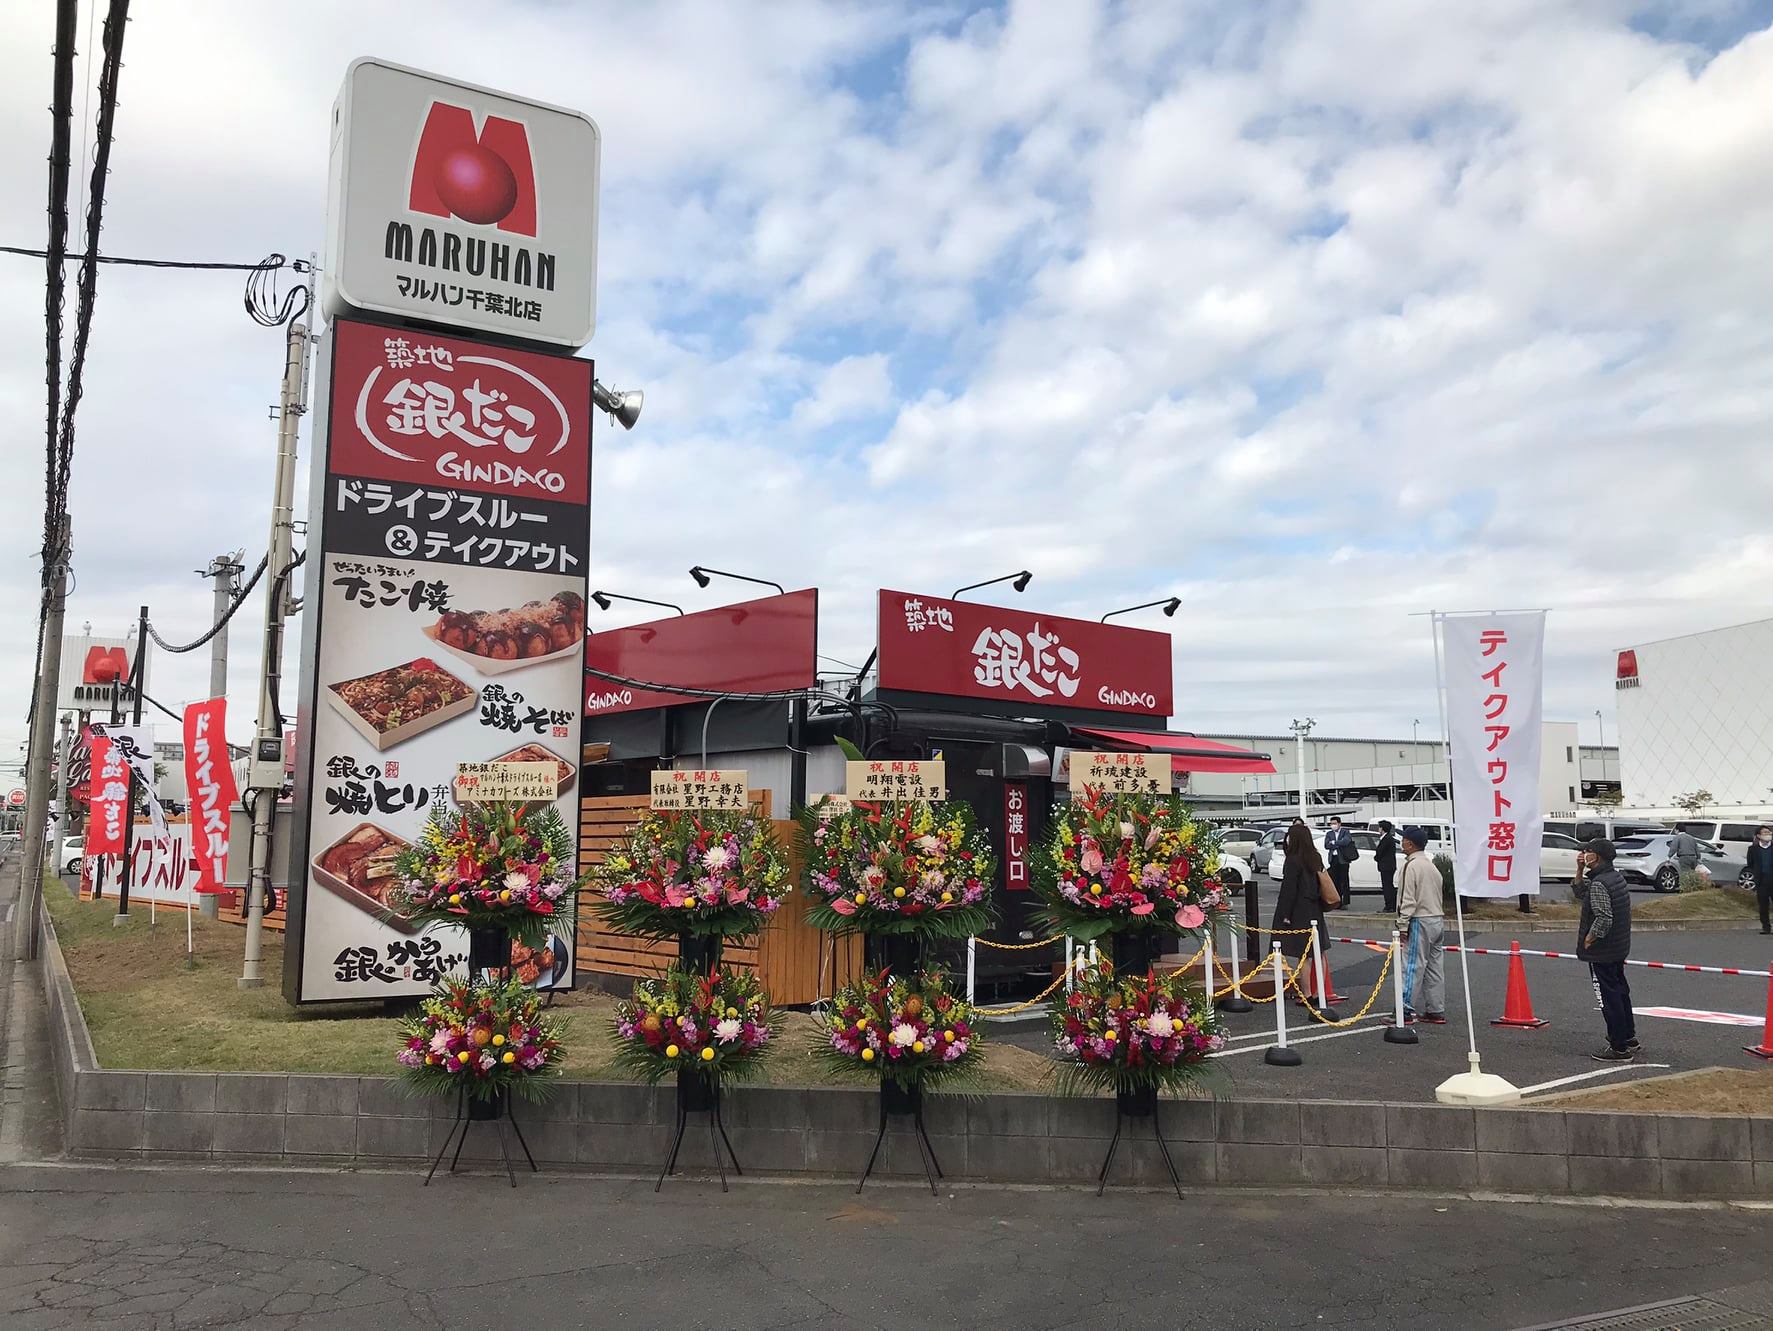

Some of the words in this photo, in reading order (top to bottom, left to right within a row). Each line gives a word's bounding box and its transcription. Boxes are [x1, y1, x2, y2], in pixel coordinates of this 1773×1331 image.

[384, 220, 556, 292] MARUHAN
[396, 274, 543, 323] マルハン千葉北店
[384, 338, 454, 371] 築地
[382, 378, 538, 454] 銀だこ
[435, 451, 566, 493] GINDACO
[337, 479, 549, 529] ドライブスルー
[904, 599, 954, 632] 築地
[971, 621, 1081, 698] 銀だこ
[482, 684, 525, 705] 銀の
[588, 690, 632, 710] GINDACO
[1098, 686, 1156, 708] GINDACO
[480, 703, 575, 734] 焼そば
[326, 755, 381, 780] 銀の
[459, 763, 508, 773] 築地銀だこ
[1479, 630, 1516, 882] テイクアウト窓口
[683, 783, 743, 795] 星野工務店
[859, 790, 876, 798] 代表
[866, 774, 922, 786] 明翔電設
[192, 712, 229, 883] ドライブスルー
[325, 780, 429, 815] 焼とり
[430, 784, 450, 815] 弁当
[684, 795, 742, 808] 星野幸夫
[1008, 789, 1023, 880] お渡し口
